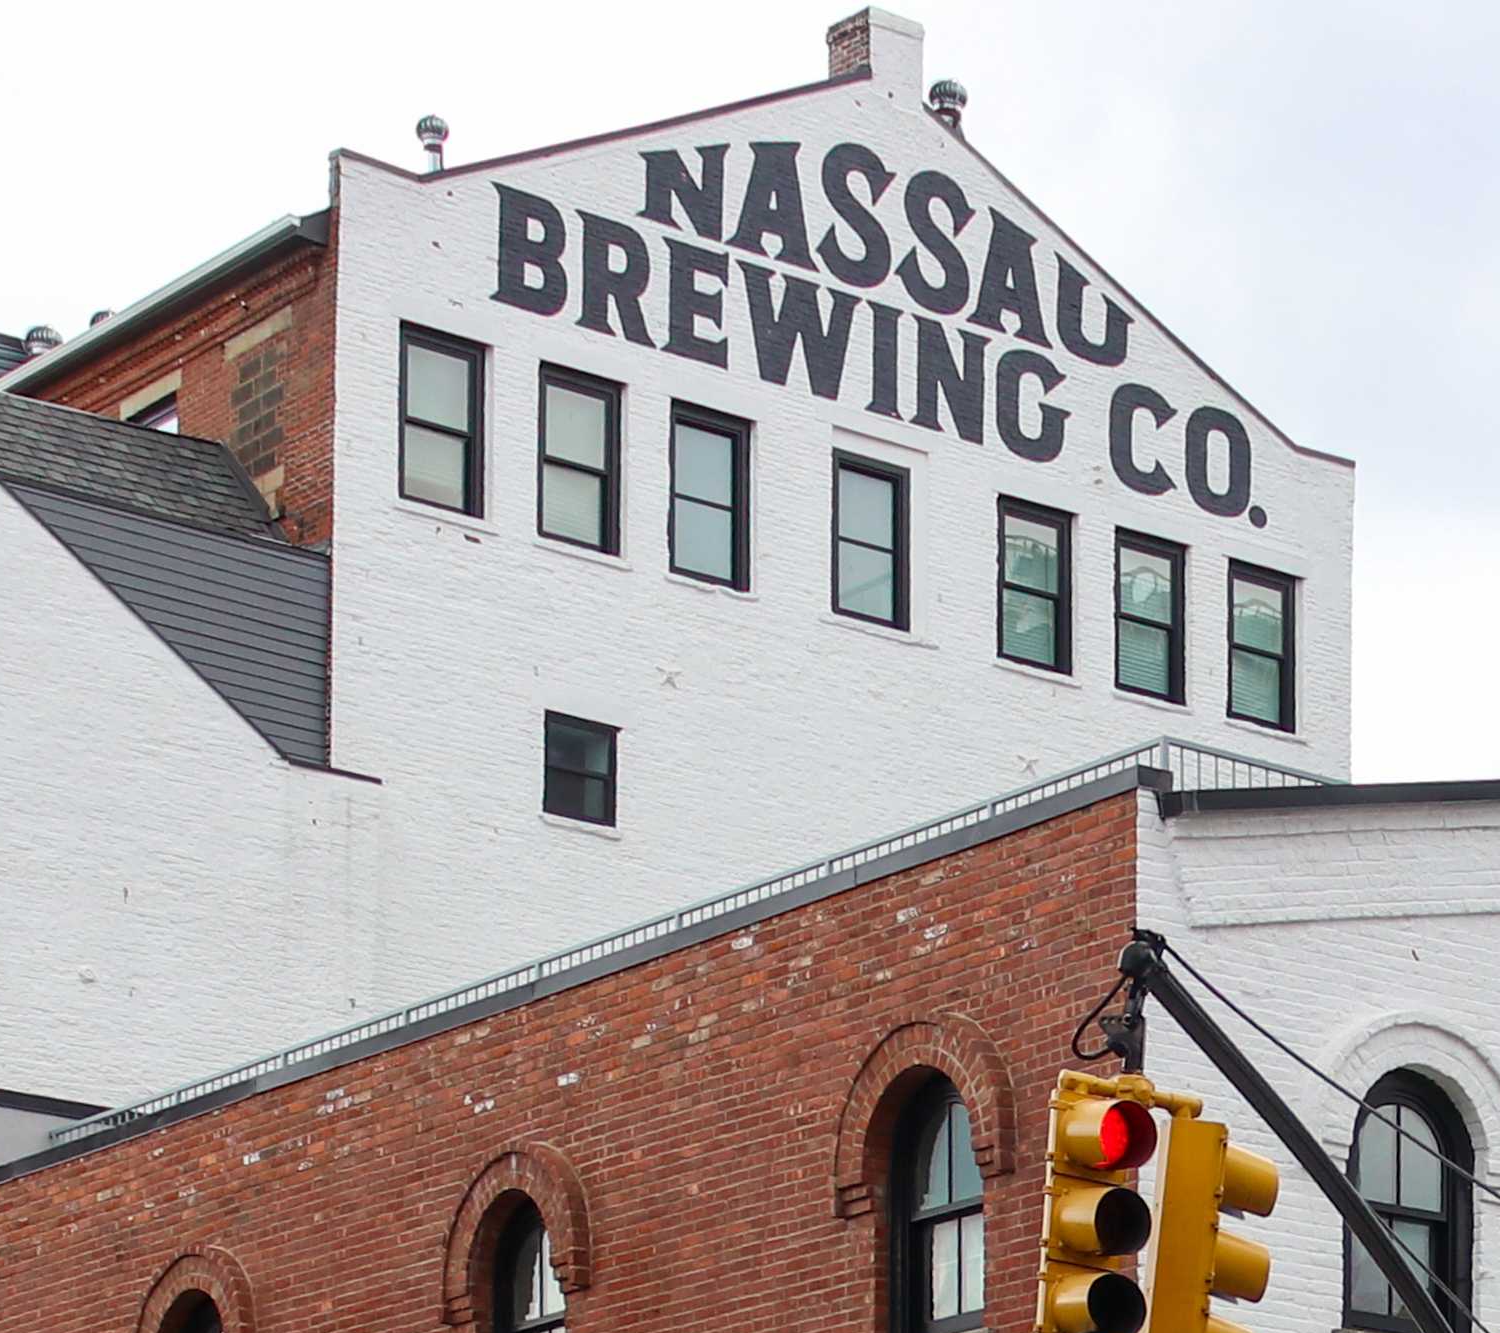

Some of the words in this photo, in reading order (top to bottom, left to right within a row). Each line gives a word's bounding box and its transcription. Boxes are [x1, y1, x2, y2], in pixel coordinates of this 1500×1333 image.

[490, 181, 1071, 464] BREWING
[1109, 382, 1268, 529] CO.
[638, 140, 1135, 367] NASSAU
